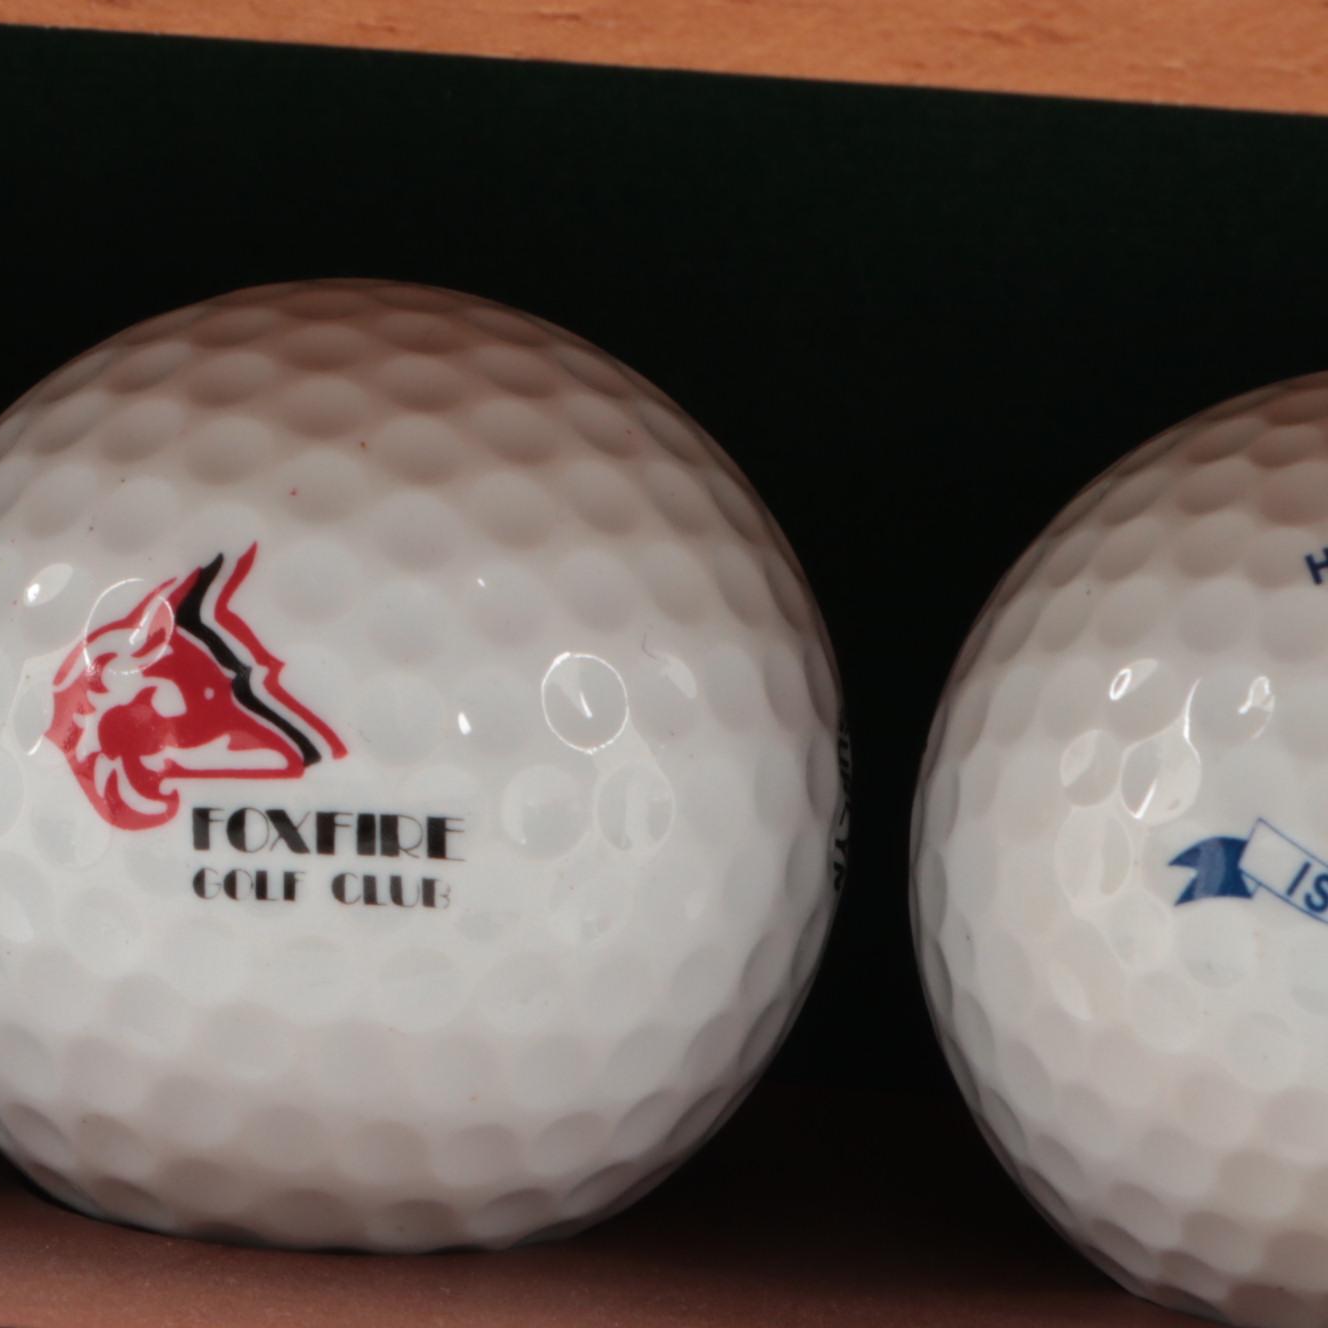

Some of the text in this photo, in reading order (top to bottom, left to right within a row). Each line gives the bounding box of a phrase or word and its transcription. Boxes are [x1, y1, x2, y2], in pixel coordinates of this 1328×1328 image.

[192, 806, 466, 862] FOXFIRE
[192, 867, 451, 908] GOLF CLUB
